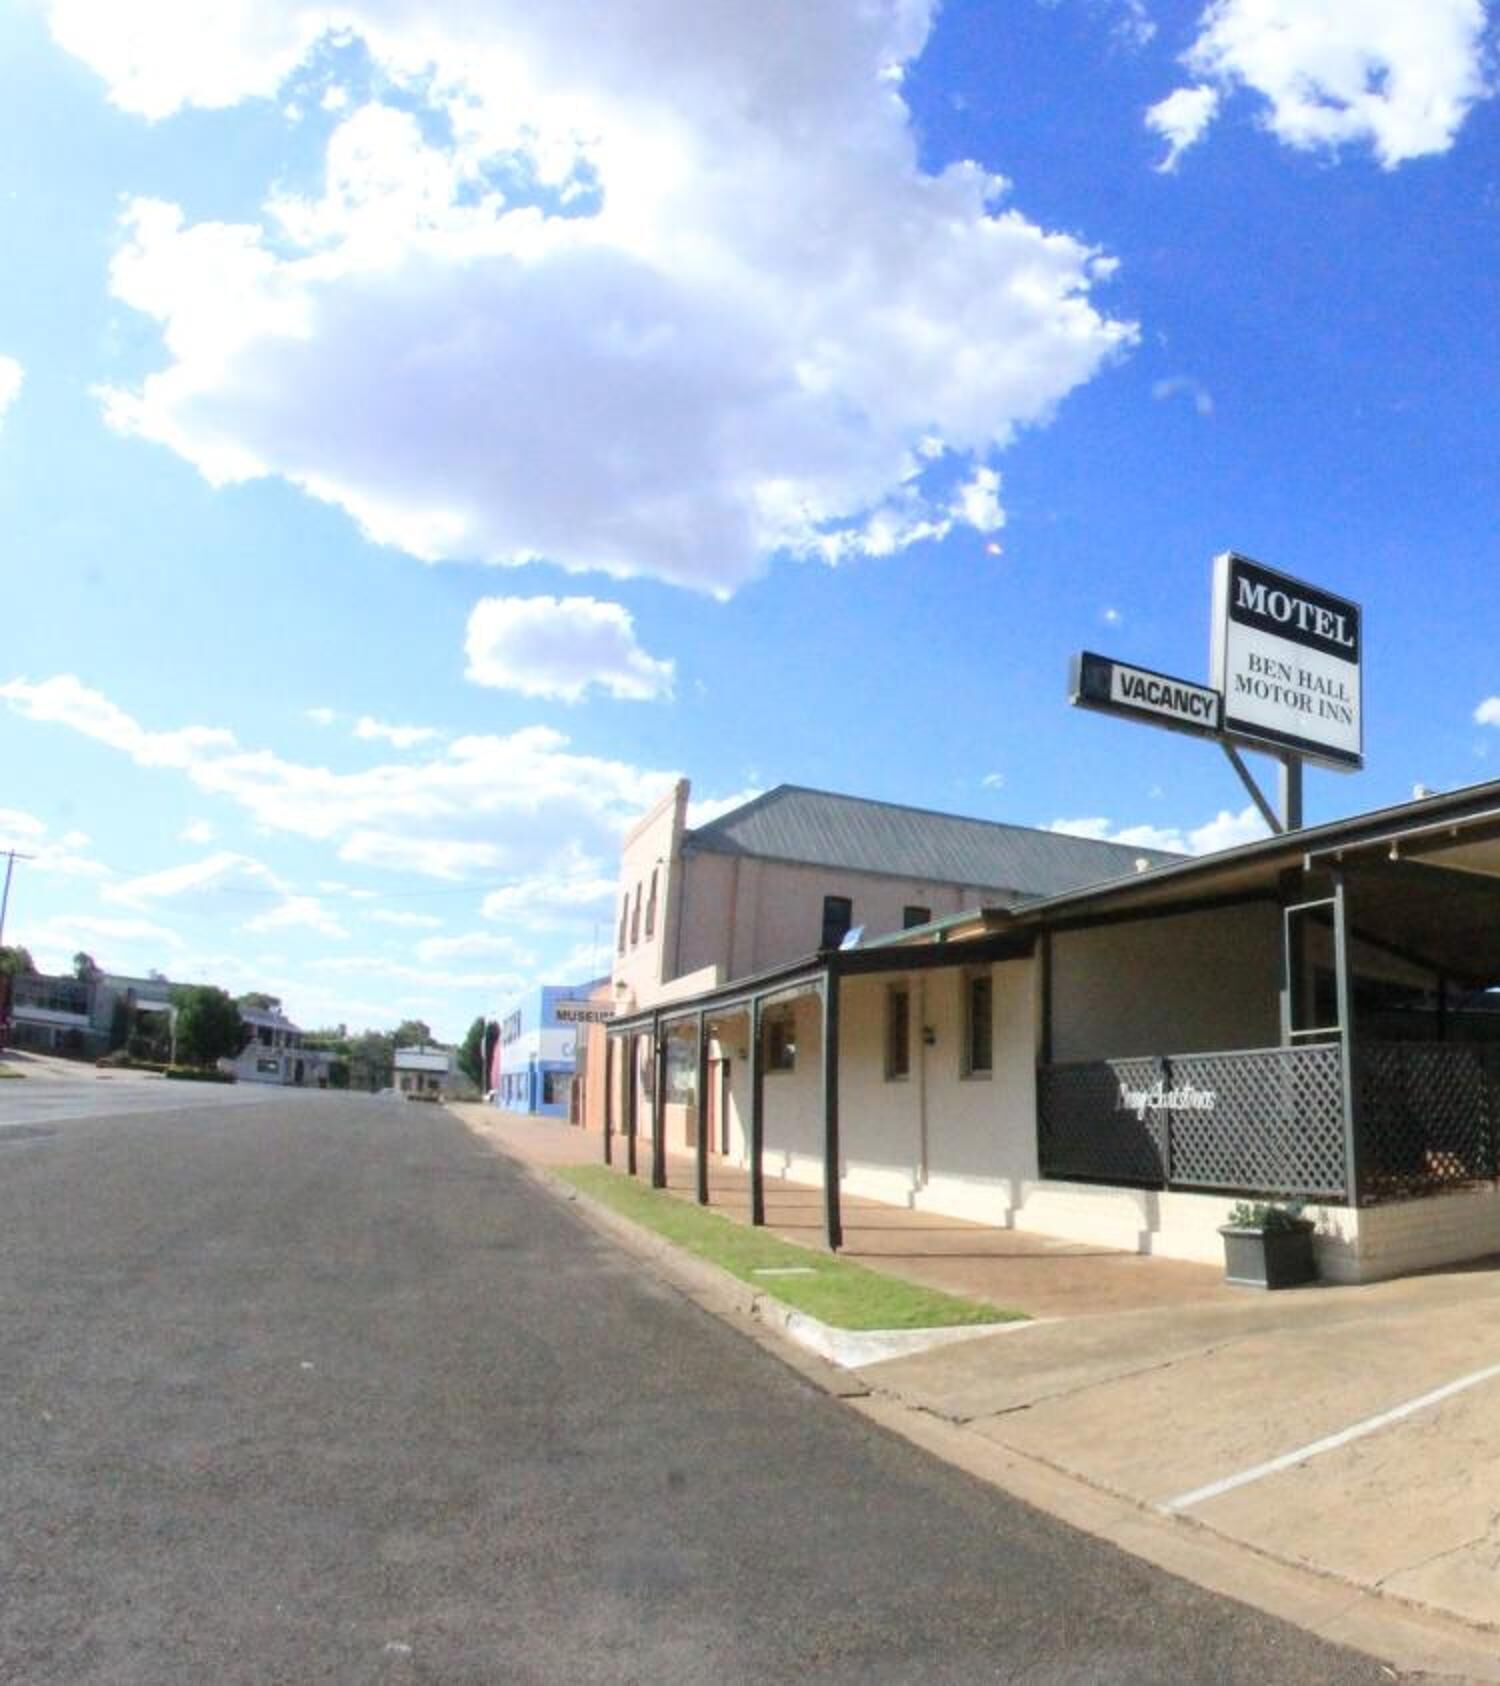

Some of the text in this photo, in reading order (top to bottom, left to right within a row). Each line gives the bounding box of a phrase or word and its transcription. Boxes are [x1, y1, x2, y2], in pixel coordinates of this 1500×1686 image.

[1237, 576, 1354, 647] MOTEL
[1120, 672, 1213, 719] VACANCY
[1234, 673, 1353, 726] MOTOR INN
[1249, 653, 1350, 700] BEN HALL
